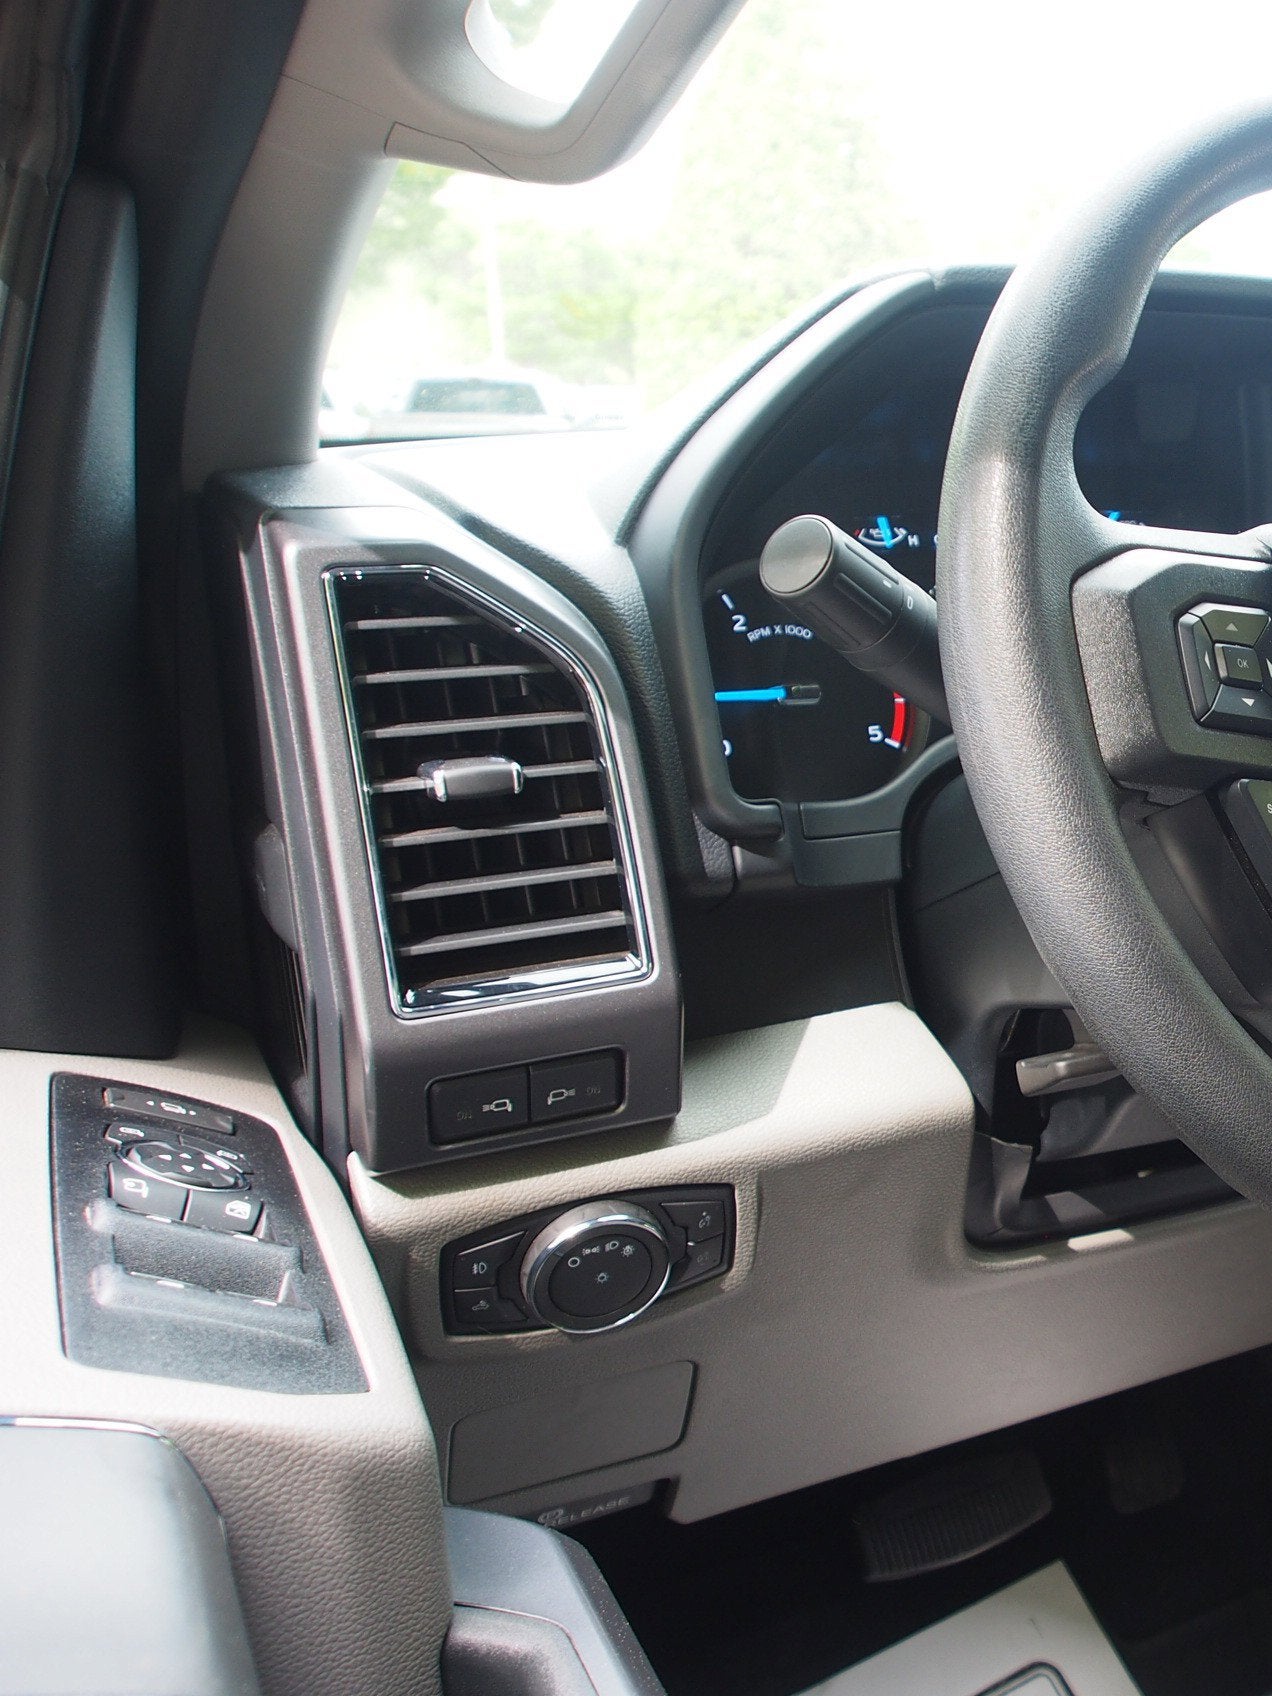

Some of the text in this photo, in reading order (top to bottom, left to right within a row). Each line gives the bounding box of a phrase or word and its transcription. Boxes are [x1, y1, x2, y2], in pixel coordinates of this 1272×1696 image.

[732, 614, 749, 632] 2
[747, 624, 813, 642] RPM X 1000
[1236, 657, 1249, 670] OK
[867, 725, 885, 742] 5
